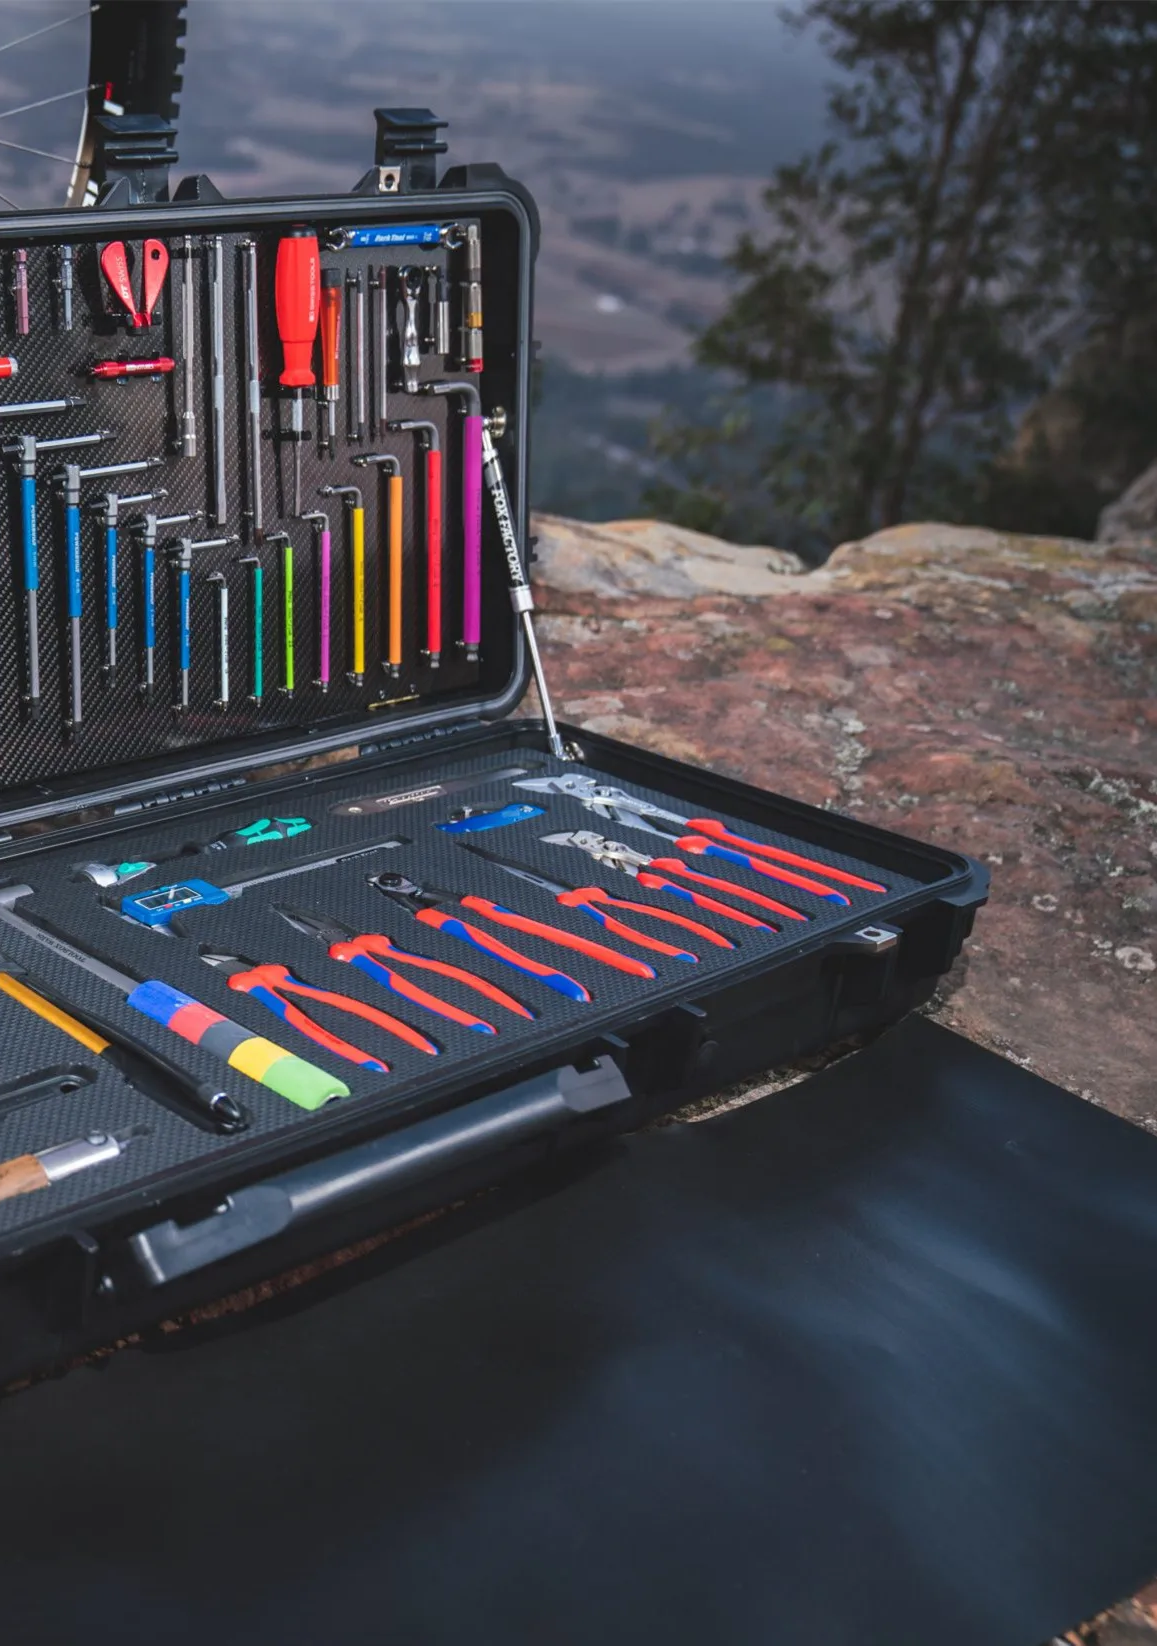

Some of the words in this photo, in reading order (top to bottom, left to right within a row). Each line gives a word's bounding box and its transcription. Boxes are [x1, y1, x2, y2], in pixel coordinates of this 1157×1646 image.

[116, 256, 126, 281] SWISS
[492, 489, 508, 519] FOX
[498, 517, 524, 587] FACTORY
